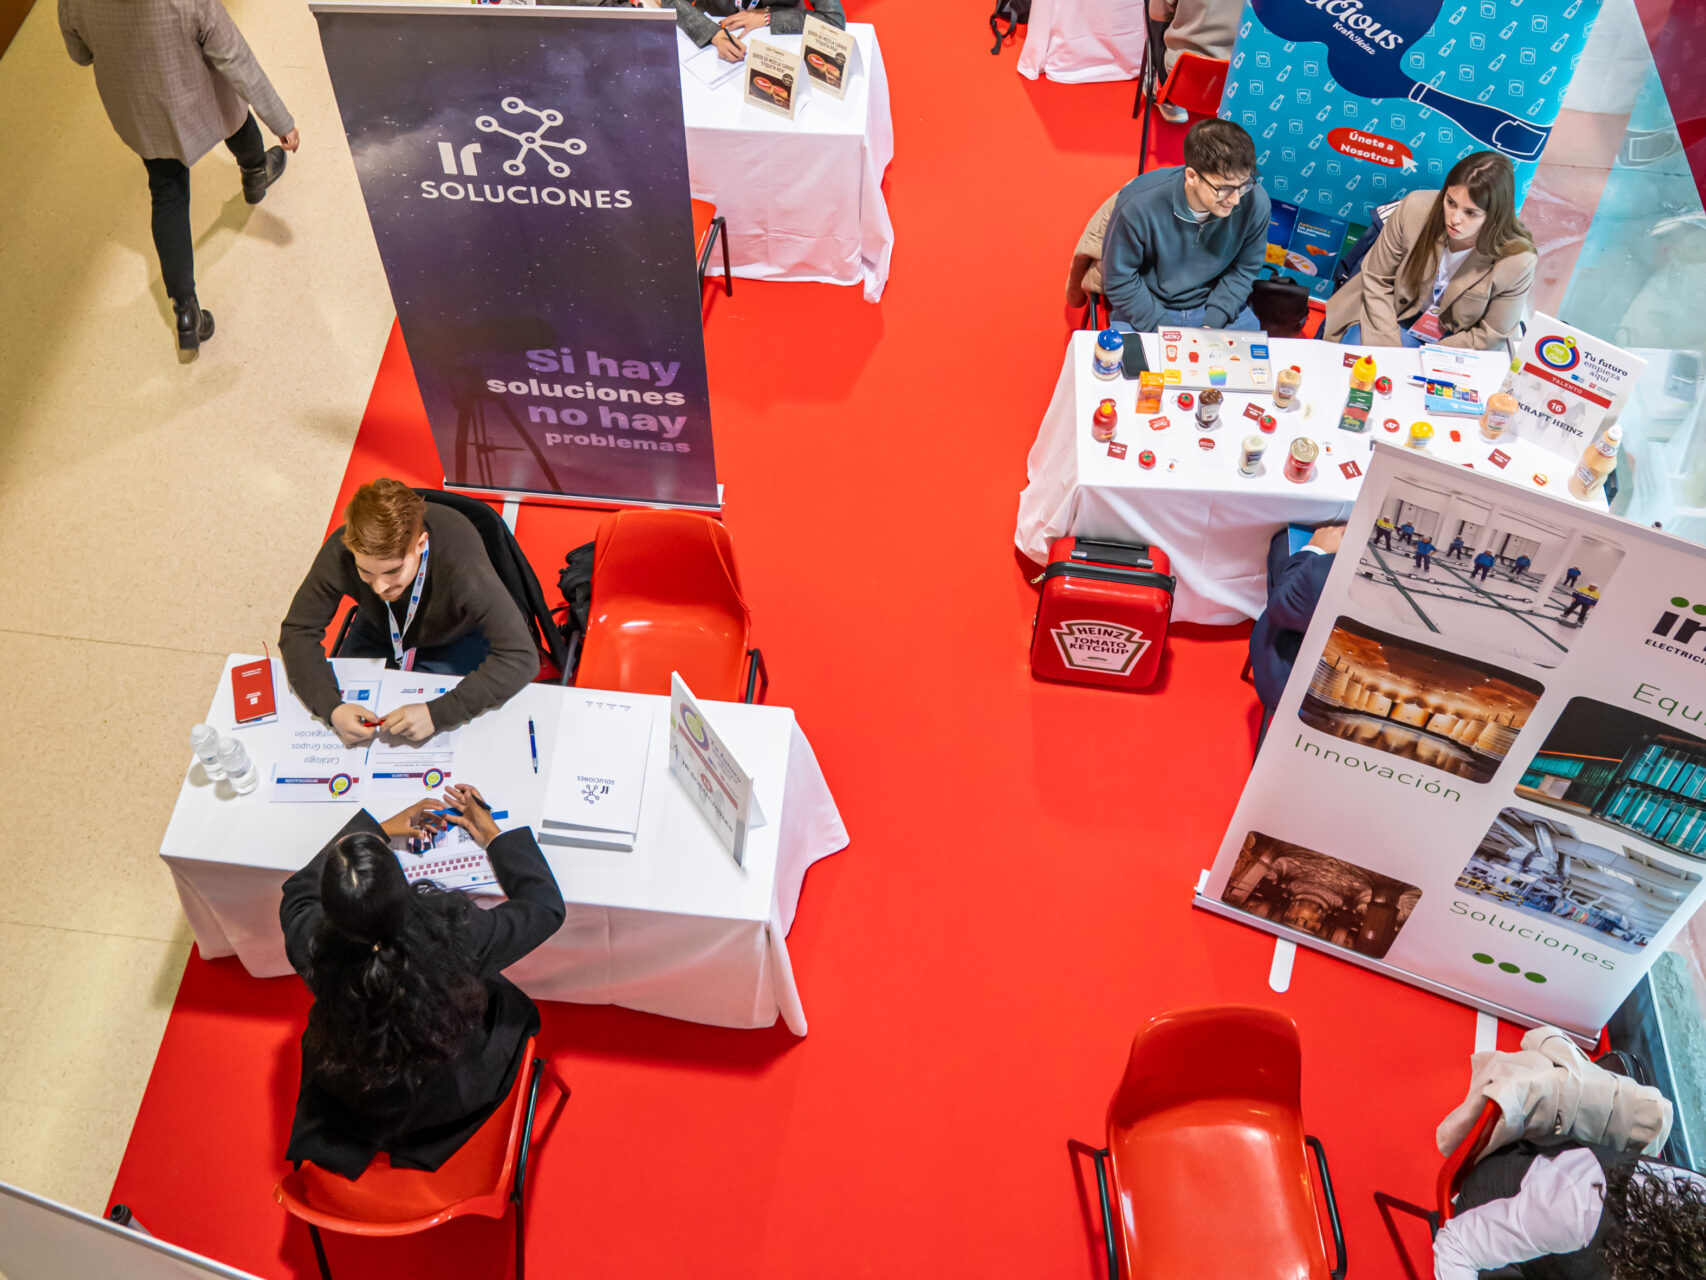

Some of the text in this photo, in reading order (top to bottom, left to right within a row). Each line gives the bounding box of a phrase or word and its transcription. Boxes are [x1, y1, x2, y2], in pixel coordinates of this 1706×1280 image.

[1349, 131, 1384, 148] Únete
[1340, 144, 1395, 166] Nosotros
[420, 180, 633, 209] SOLUCIONES
[526, 347, 681, 387] Si hay
[1584, 351, 1628, 376] Tu futuro
[1584, 361, 1620, 381] empieza
[1552, 377, 1583, 394] TALENTO
[1589, 370, 1609, 383] aquí
[486, 378, 686, 406] soluciones
[1551, 402, 1562, 412] 16
[528, 406, 688, 439] no hay
[1518, 402, 1584, 438] KRAFT HEINZ
[545, 432, 691, 453] problemas
[1073, 636, 1127, 649] TOMATO
[1076, 626, 1125, 640] HEINZ
[1070, 643, 1130, 655] KETCHUP
[1645, 639, 1706, 666] ELECTRICI
[1632, 683, 1706, 726] Equ
[292, 742, 320, 750] Grupos
[304, 756, 340, 765] Catálogo
[1294, 734, 1462, 802] Innovación
[577, 776, 615, 785] SOLUCIONES
[1450, 900, 1616, 970] Soluciones
